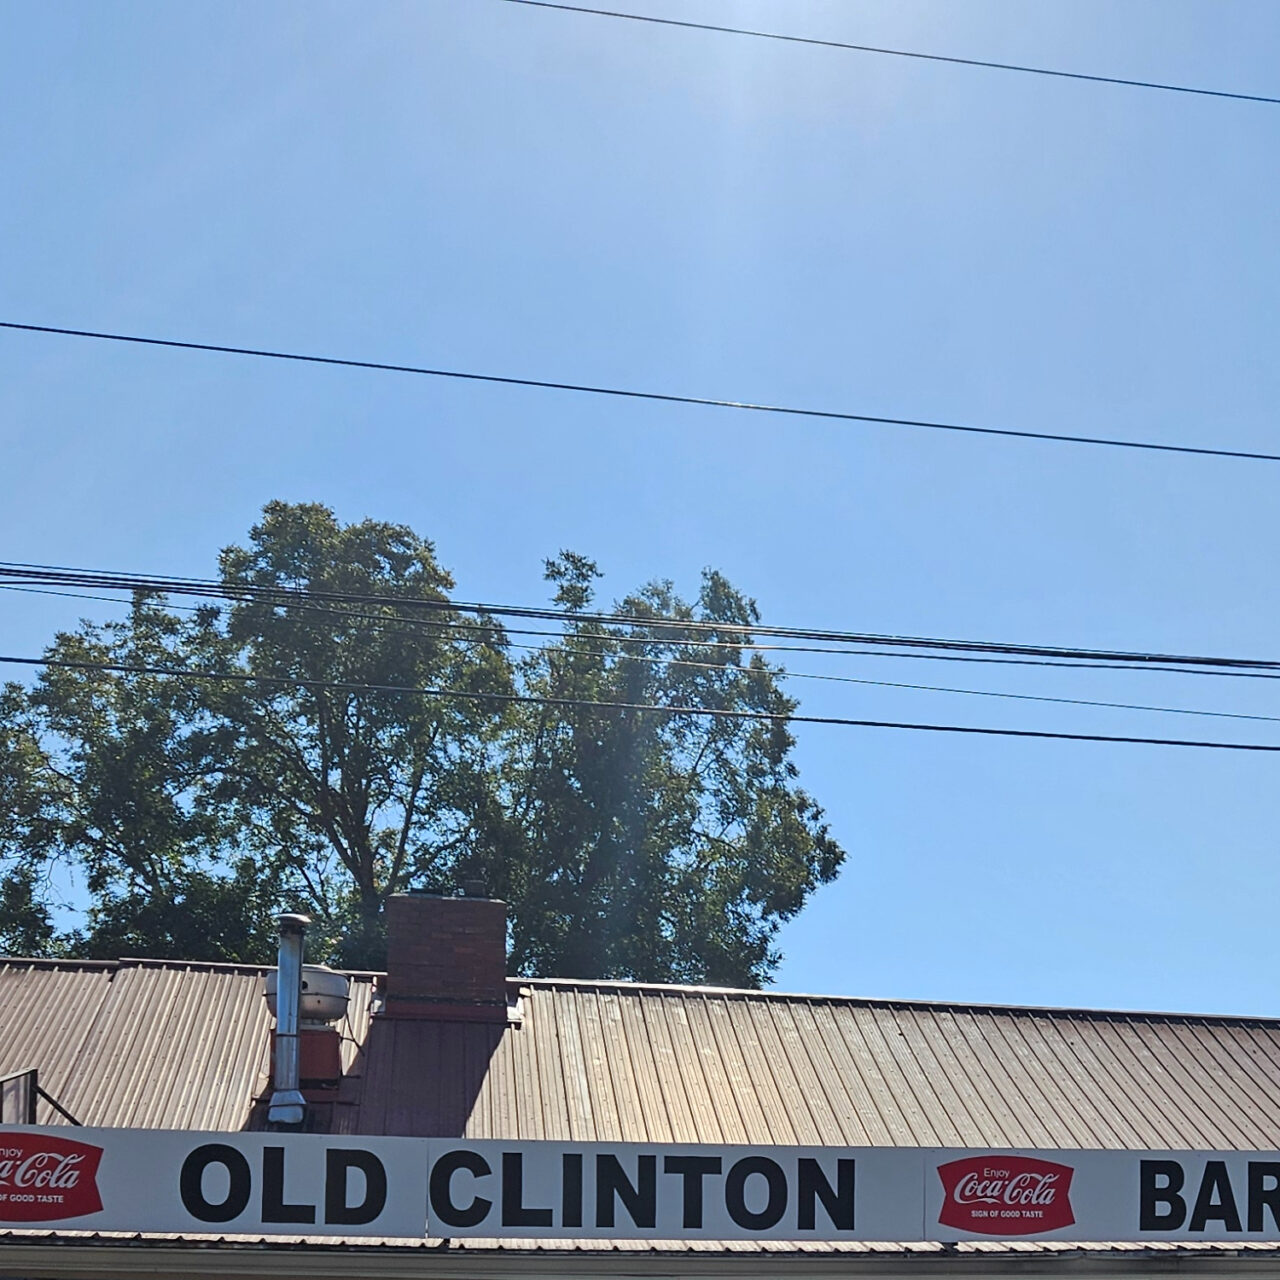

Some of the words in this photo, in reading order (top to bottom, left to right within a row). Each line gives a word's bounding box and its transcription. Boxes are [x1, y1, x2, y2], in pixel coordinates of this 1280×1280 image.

[0, 1148, 23, 1158] njoy
[983, 1167, 1010, 1178] Enjoy
[179, 1143, 388, 1225] OLD
[428, 1150, 856, 1231] CLINTON
[9, 1194, 35, 1202] GOOD
[36, 1195, 64, 1203] TASTE
[1000, 1210, 1020, 1218] GOOD
[1022, 1210, 1043, 1218] TASTE
